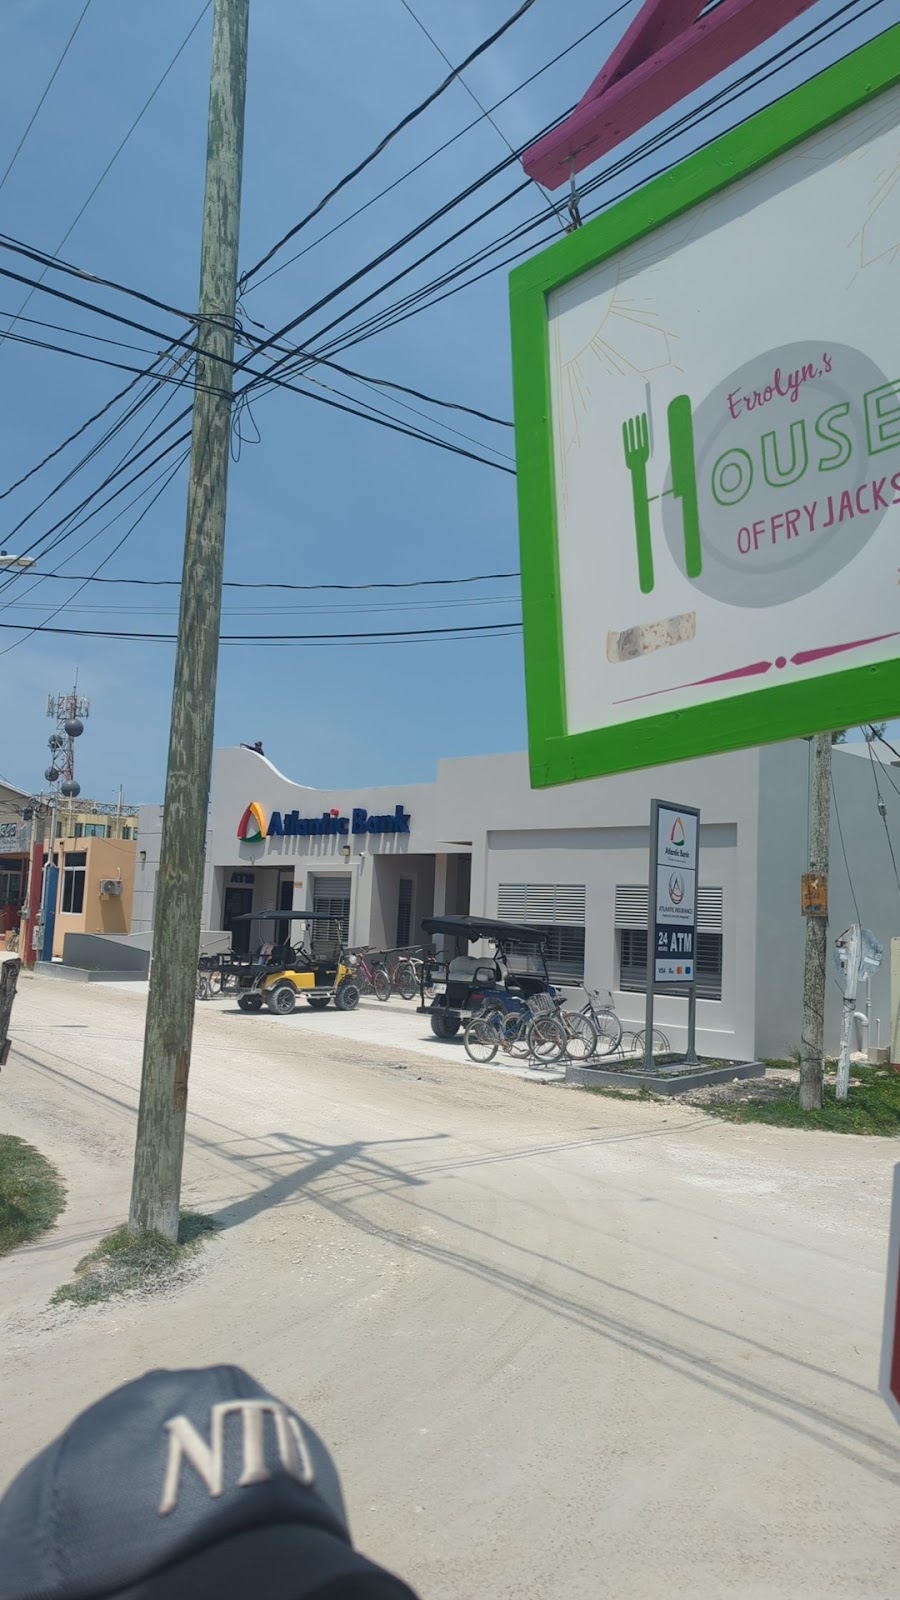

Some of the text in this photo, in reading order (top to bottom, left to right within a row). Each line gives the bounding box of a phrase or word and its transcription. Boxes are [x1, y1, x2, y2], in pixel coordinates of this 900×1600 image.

[266, 805, 411, 836] Atlantic Bank
[665, 847, 690, 858] Atlantic Bank
[658, 931, 692, 952] 24 ATM
